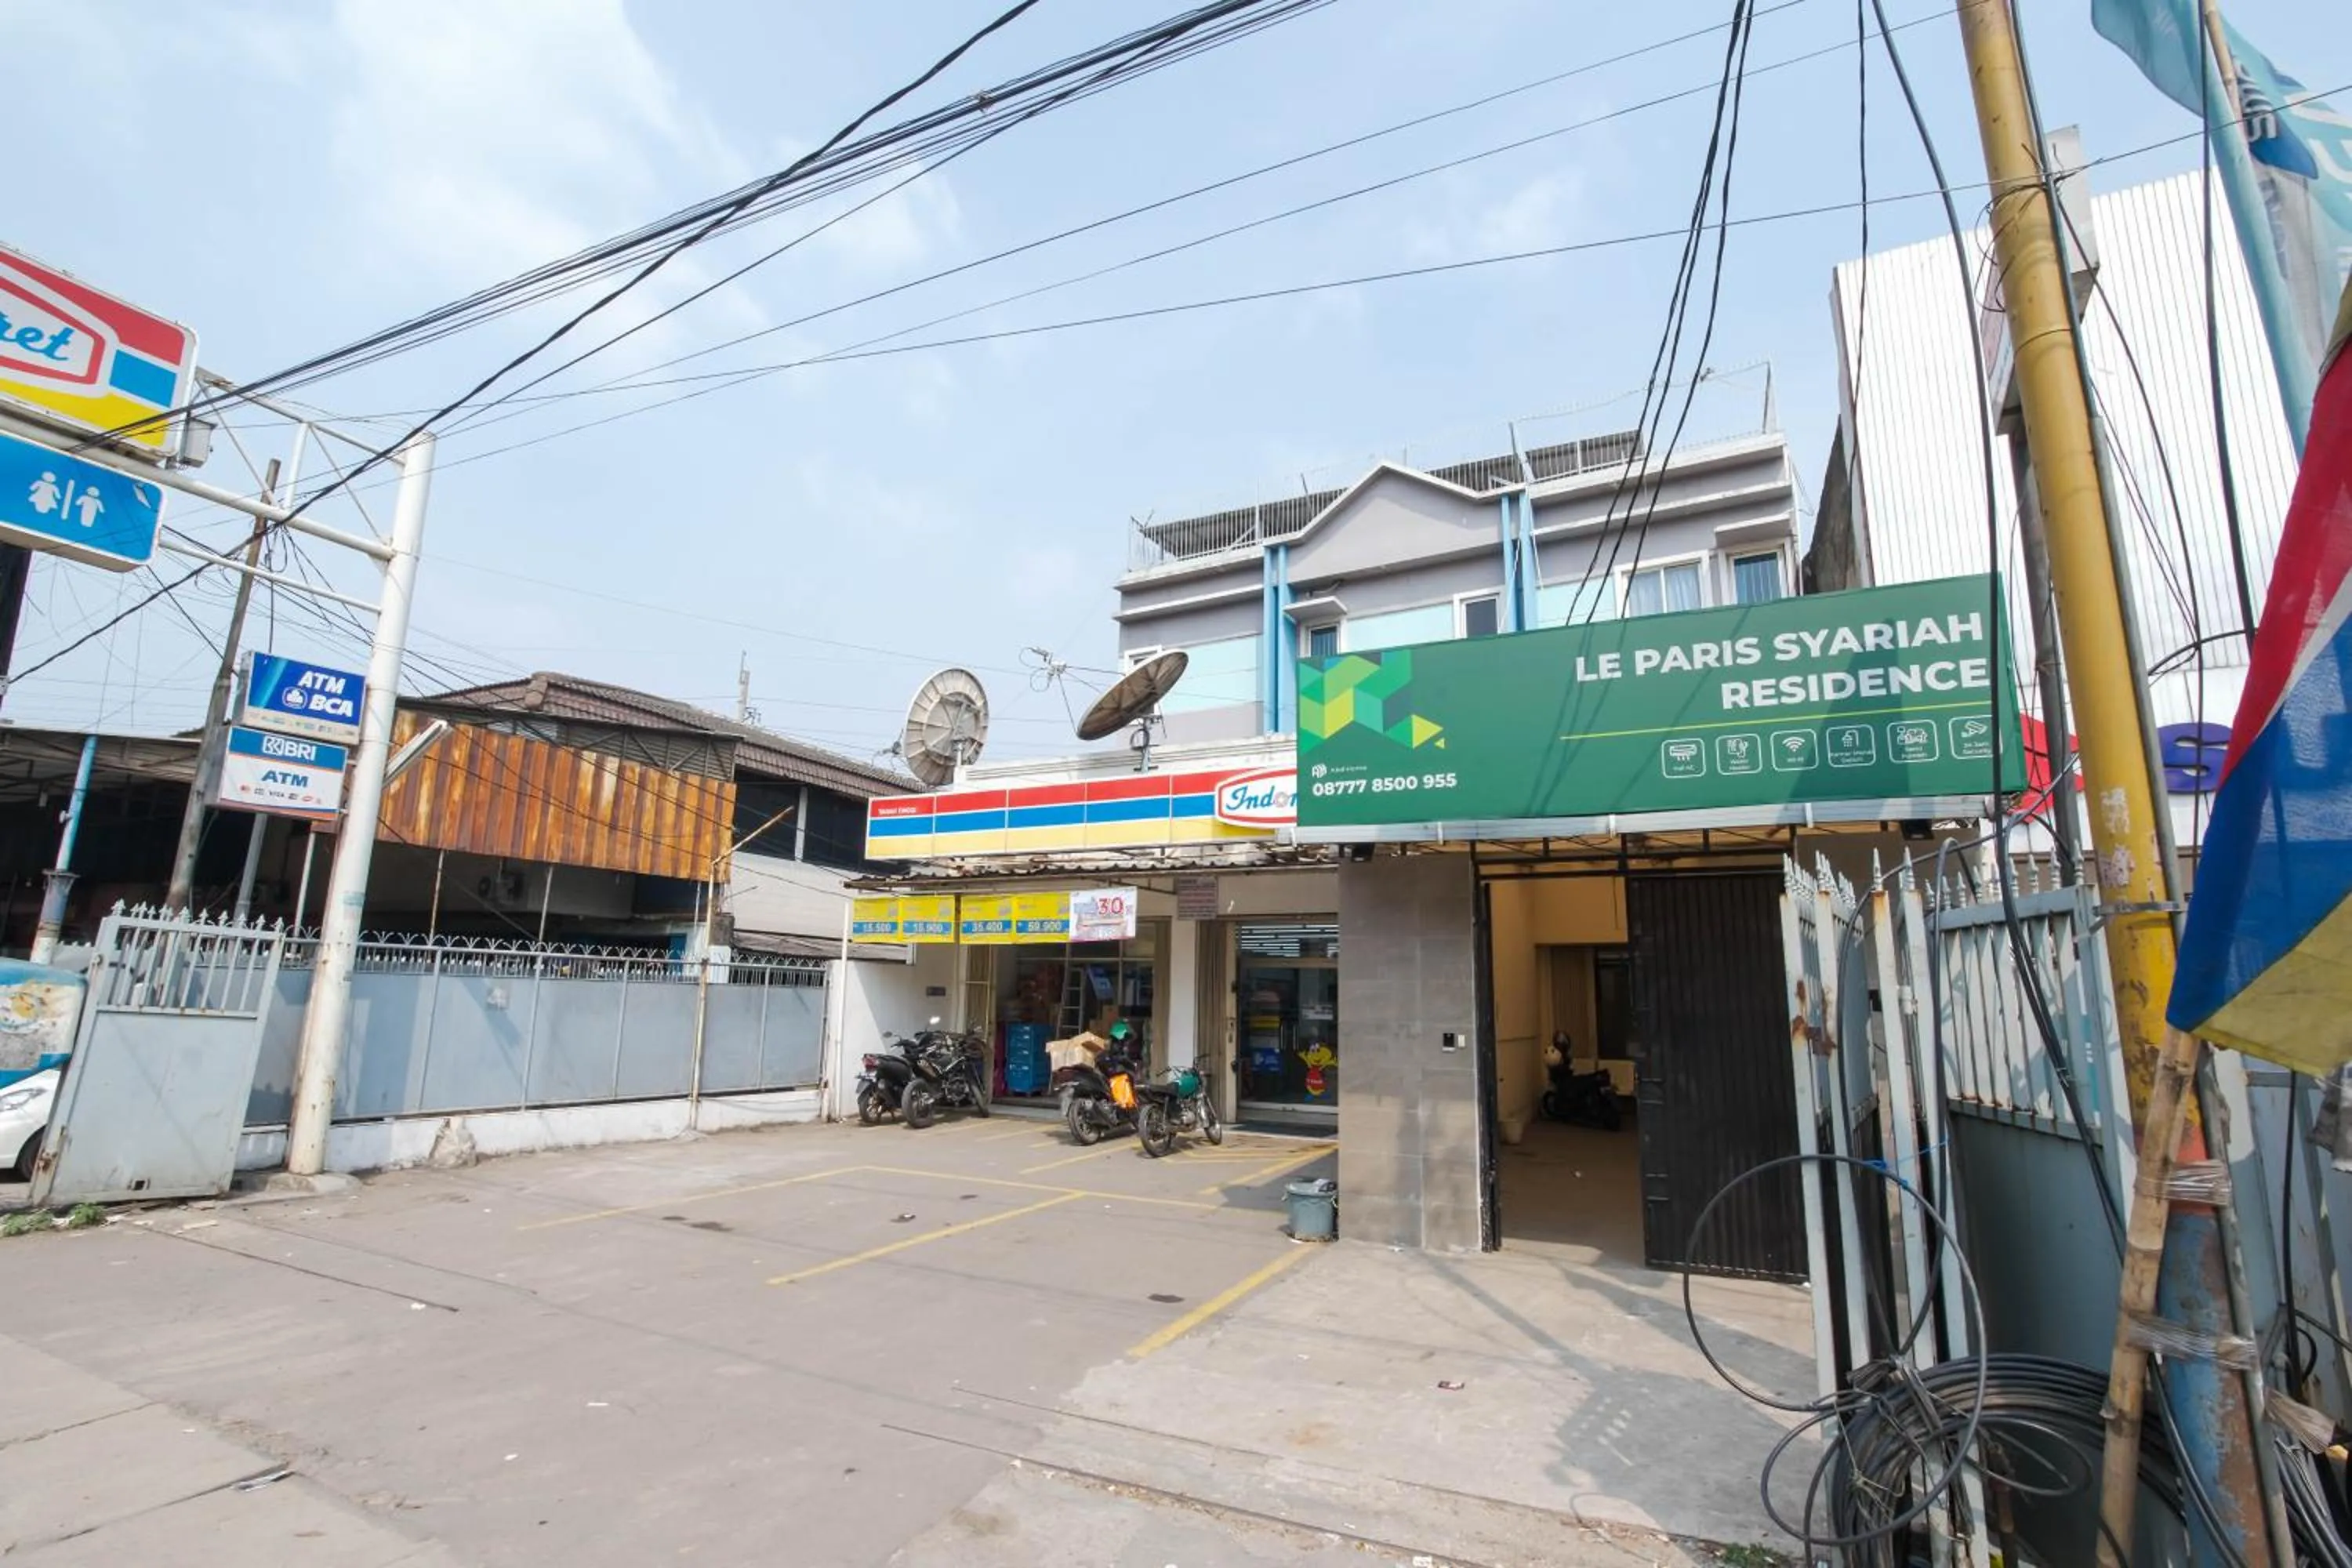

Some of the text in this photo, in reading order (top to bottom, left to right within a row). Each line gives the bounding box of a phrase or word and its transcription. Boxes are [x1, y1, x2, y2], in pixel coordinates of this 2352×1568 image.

[1575, 612, 1984, 682] LE PARIS SYARIAH
[298, 670, 346, 694] ATM
[1721, 657, 1991, 710] RESIDENCE
[308, 694, 354, 717] BCA
[284, 739, 318, 761] BRI
[262, 770, 309, 787] ATM
[1312, 772, 1457, 797] 08777 8500 955
[1098, 896, 1124, 915] 30
